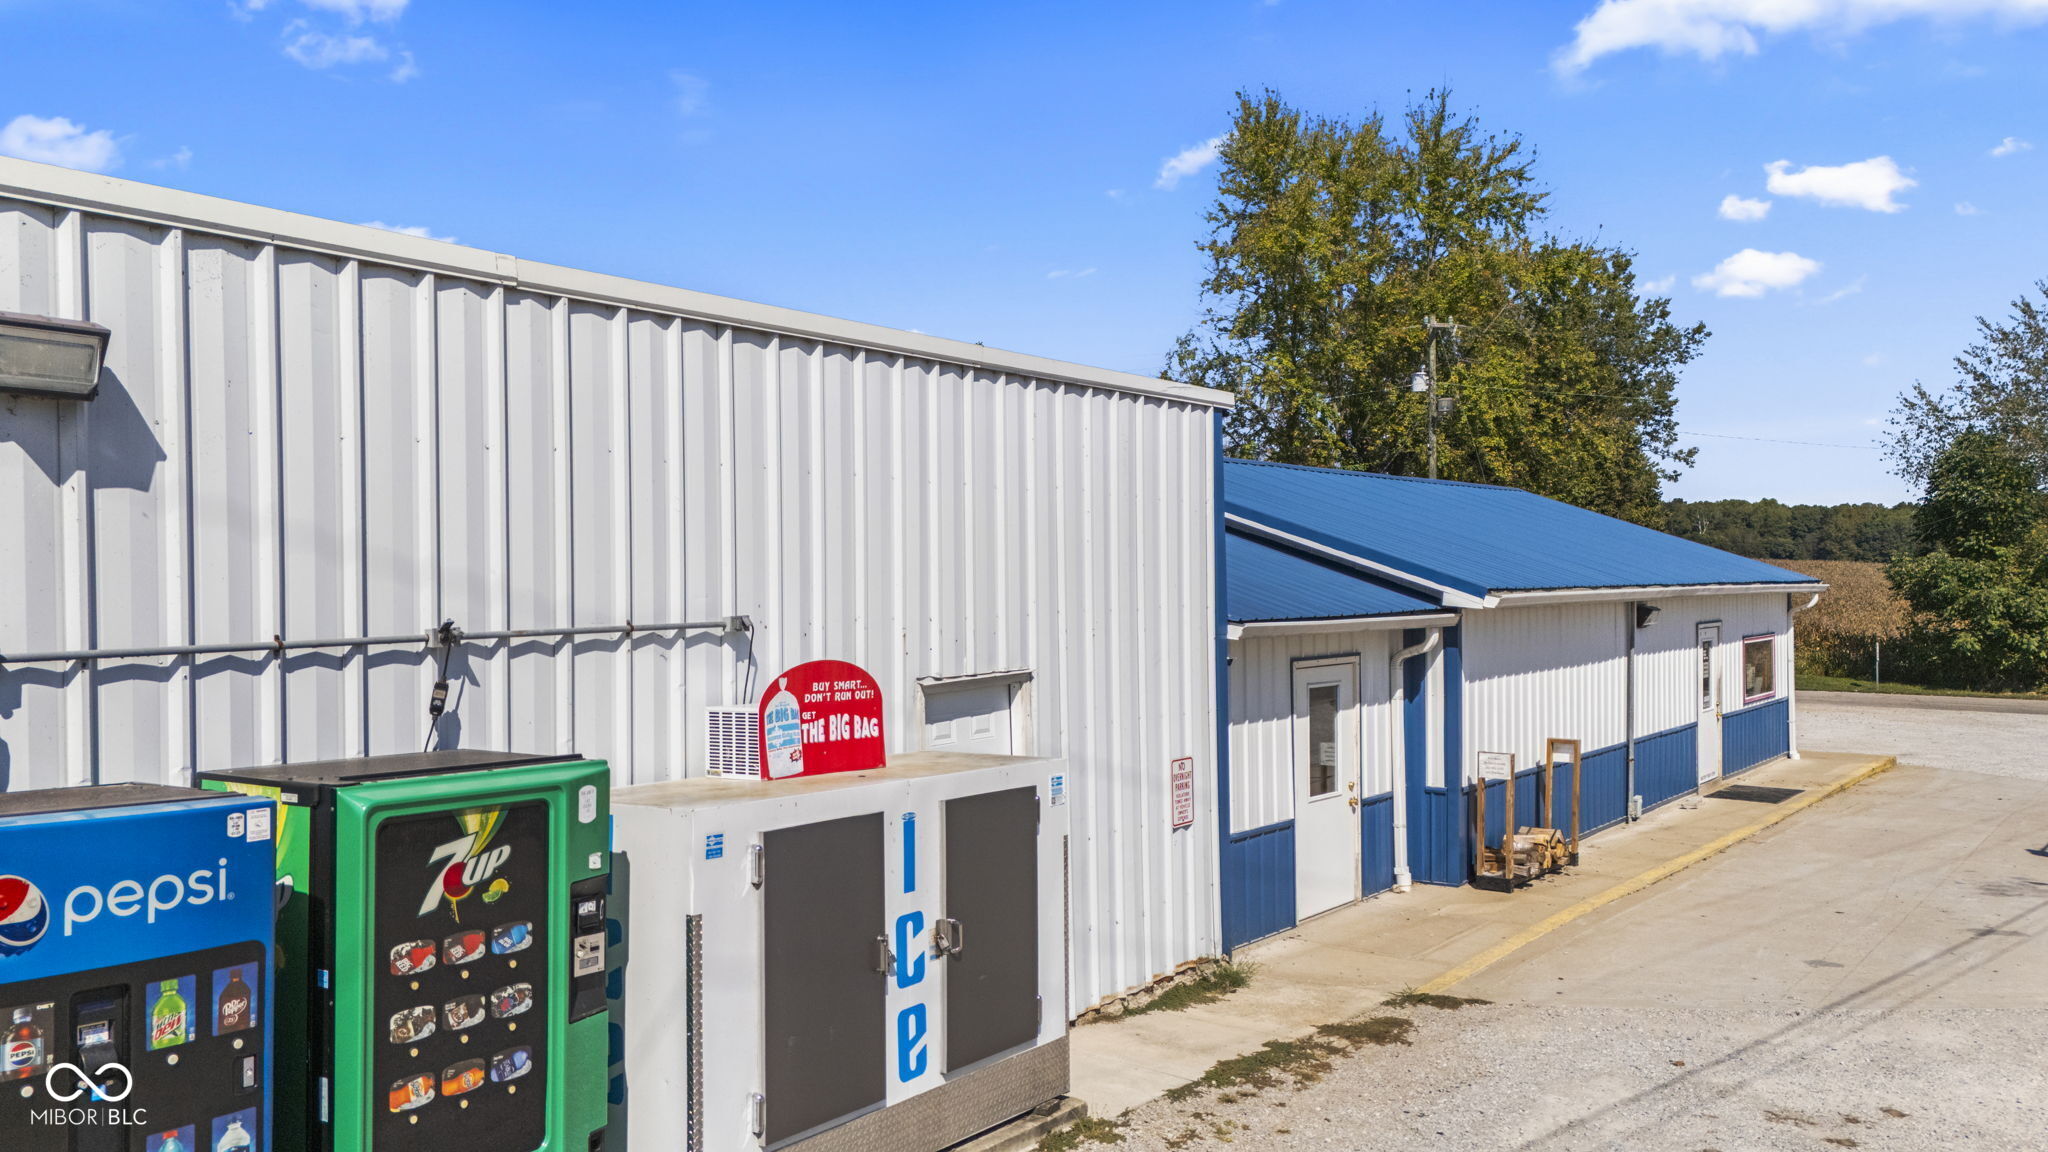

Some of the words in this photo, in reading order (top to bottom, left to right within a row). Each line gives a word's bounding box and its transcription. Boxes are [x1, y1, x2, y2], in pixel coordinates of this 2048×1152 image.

[812, 682, 830, 692] BUY
[833, 680, 867, 690] SMART...
[804, 692, 831, 703] DON'T
[834, 691, 852, 701] RUN
[854, 690, 875, 699] OUT!
[802, 711, 816, 720] GET
[801, 718, 826, 744] THE
[829, 713, 850, 742] BIG
[854, 714, 879, 739] BAG
[1175, 781, 1190, 791] PARKING
[63, 857, 228, 937] pepsi
[9, 1049, 35, 1059] PEPSI
